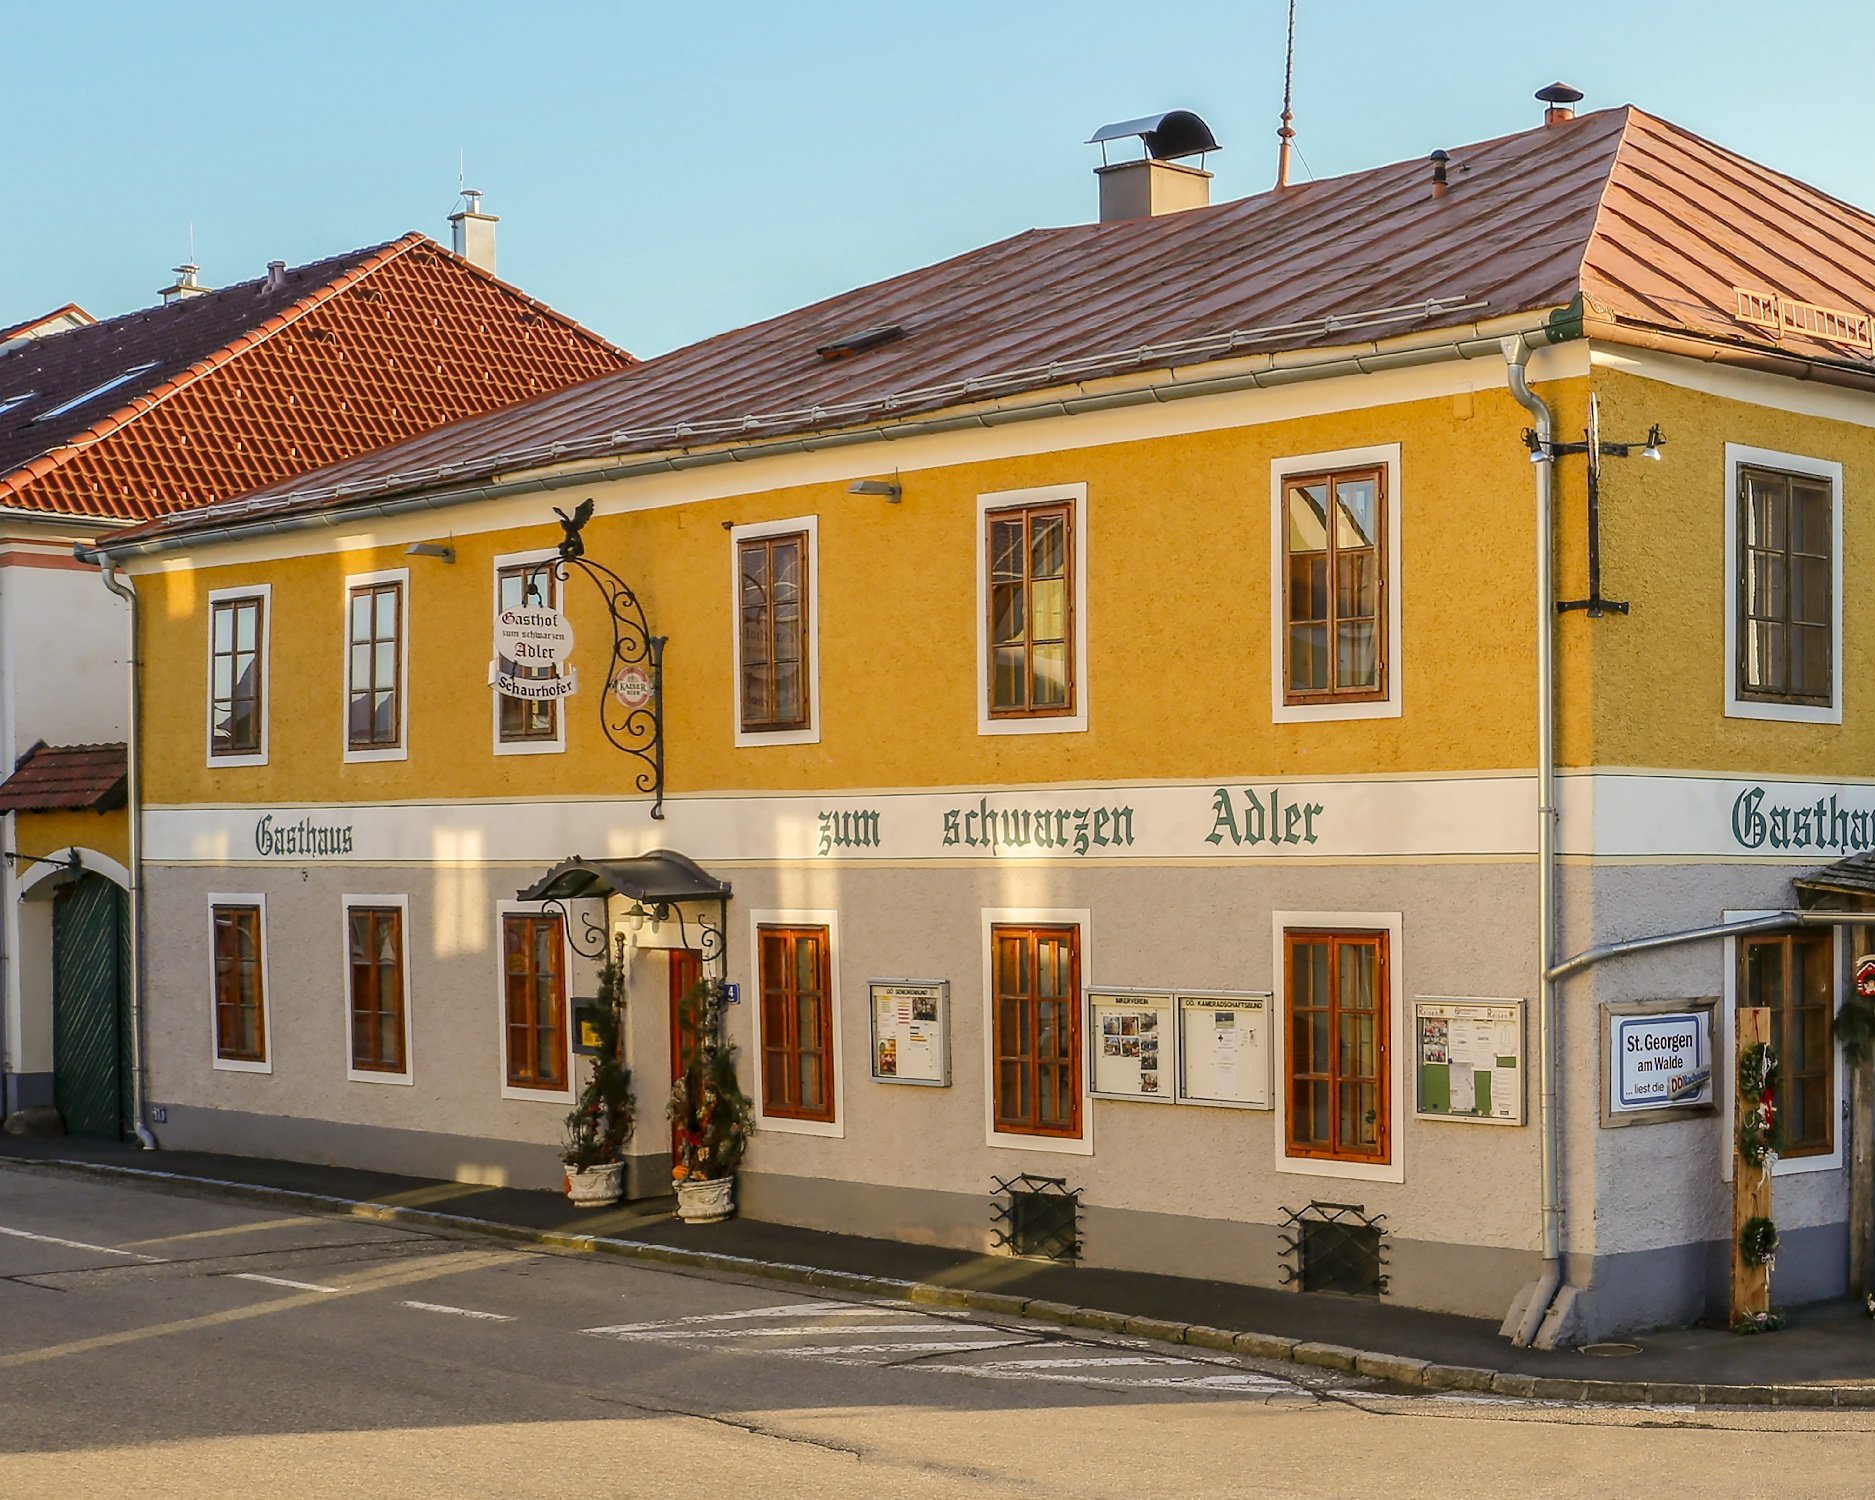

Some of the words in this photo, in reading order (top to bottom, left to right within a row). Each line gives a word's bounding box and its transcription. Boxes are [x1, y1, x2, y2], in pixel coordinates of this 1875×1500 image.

[501, 612, 558, 628] Gasthof
[502, 630, 519, 639] zum
[521, 630, 565, 641] schwarzen
[515, 642, 555, 659] Adler
[498, 675, 573, 698] Schaurhofer
[619, 682, 646, 692] KAISER
[817, 808, 881, 856] zum
[942, 796, 1135, 857] schwarzen
[1205, 787, 1325, 847] Adler
[255, 814, 353, 858] Gasthaus
[1197, 1000, 1263, 1009] KAMERADSCHAFTSBUND
[1627, 1034, 1643, 1052] St.
[1644, 1033, 1693, 1053] Georgen
[1637, 1060, 1653, 1072] am
[1654, 1055, 1684, 1071] Walde
[1634, 1083, 1651, 1094] liest
[1652, 1081, 1665, 1092] die
